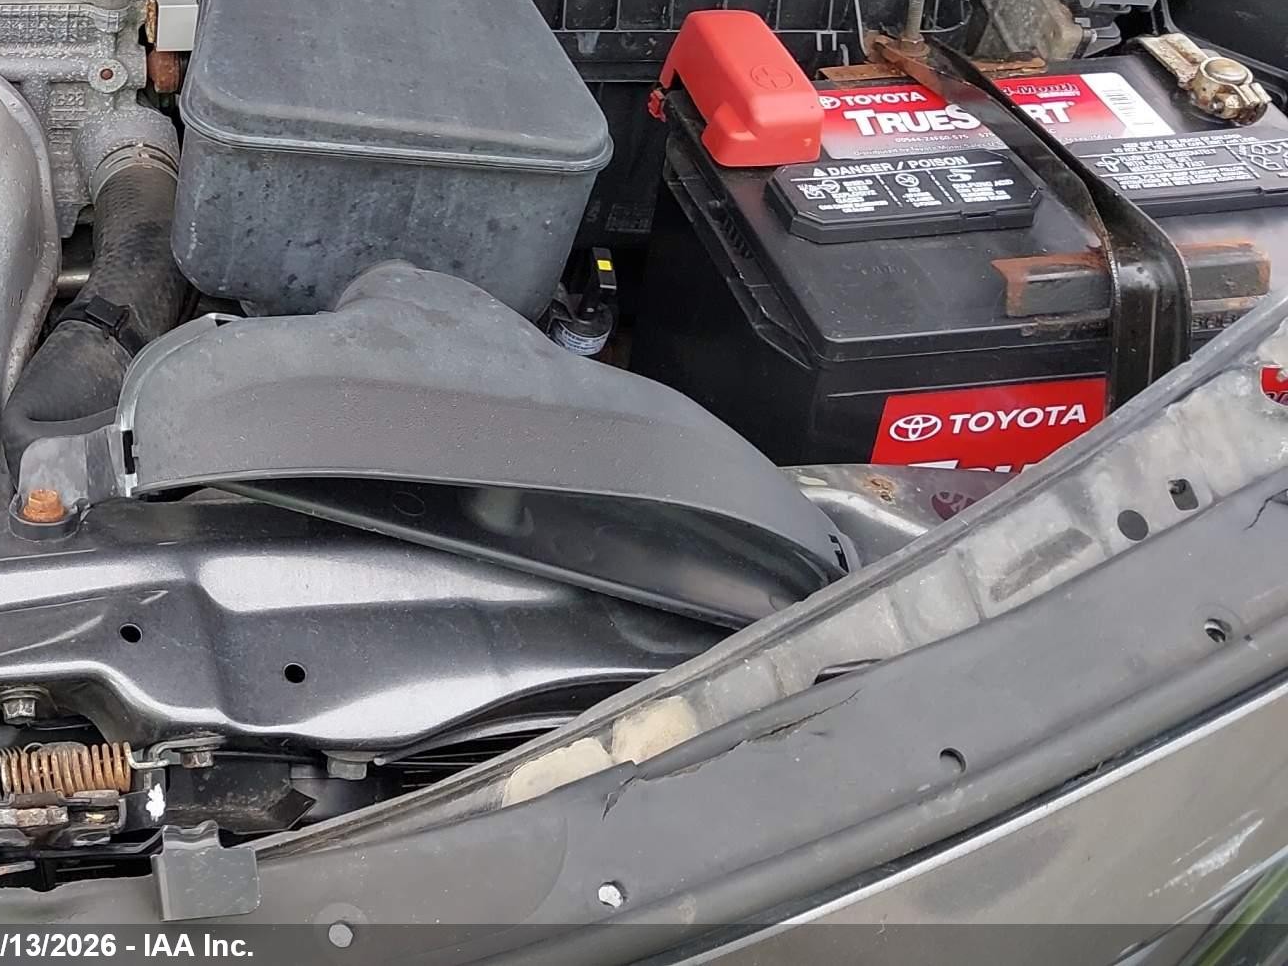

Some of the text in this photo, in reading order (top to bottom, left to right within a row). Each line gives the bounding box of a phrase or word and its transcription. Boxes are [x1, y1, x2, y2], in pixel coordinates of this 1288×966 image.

[839, 91, 927, 107] TOYOTA
[826, 155, 969, 177] DANGER / POISON
[948, 404, 1087, 434] TOYOTA
